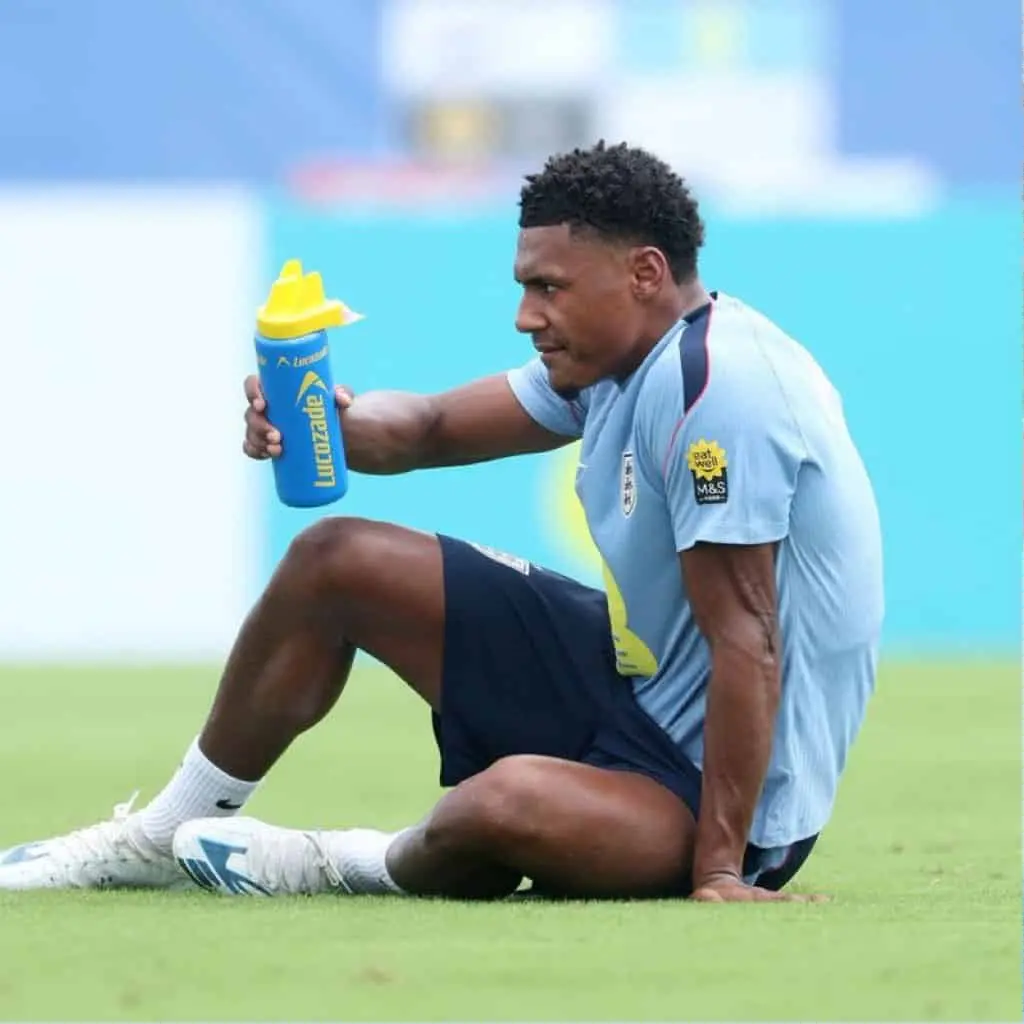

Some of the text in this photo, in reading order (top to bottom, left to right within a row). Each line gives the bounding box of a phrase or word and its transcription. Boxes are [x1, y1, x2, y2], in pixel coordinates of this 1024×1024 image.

[302, 394, 336, 488] Lucozade
[694, 448, 712, 461] eat
[695, 455, 719, 468] well
[697, 481, 726, 495] M&S
